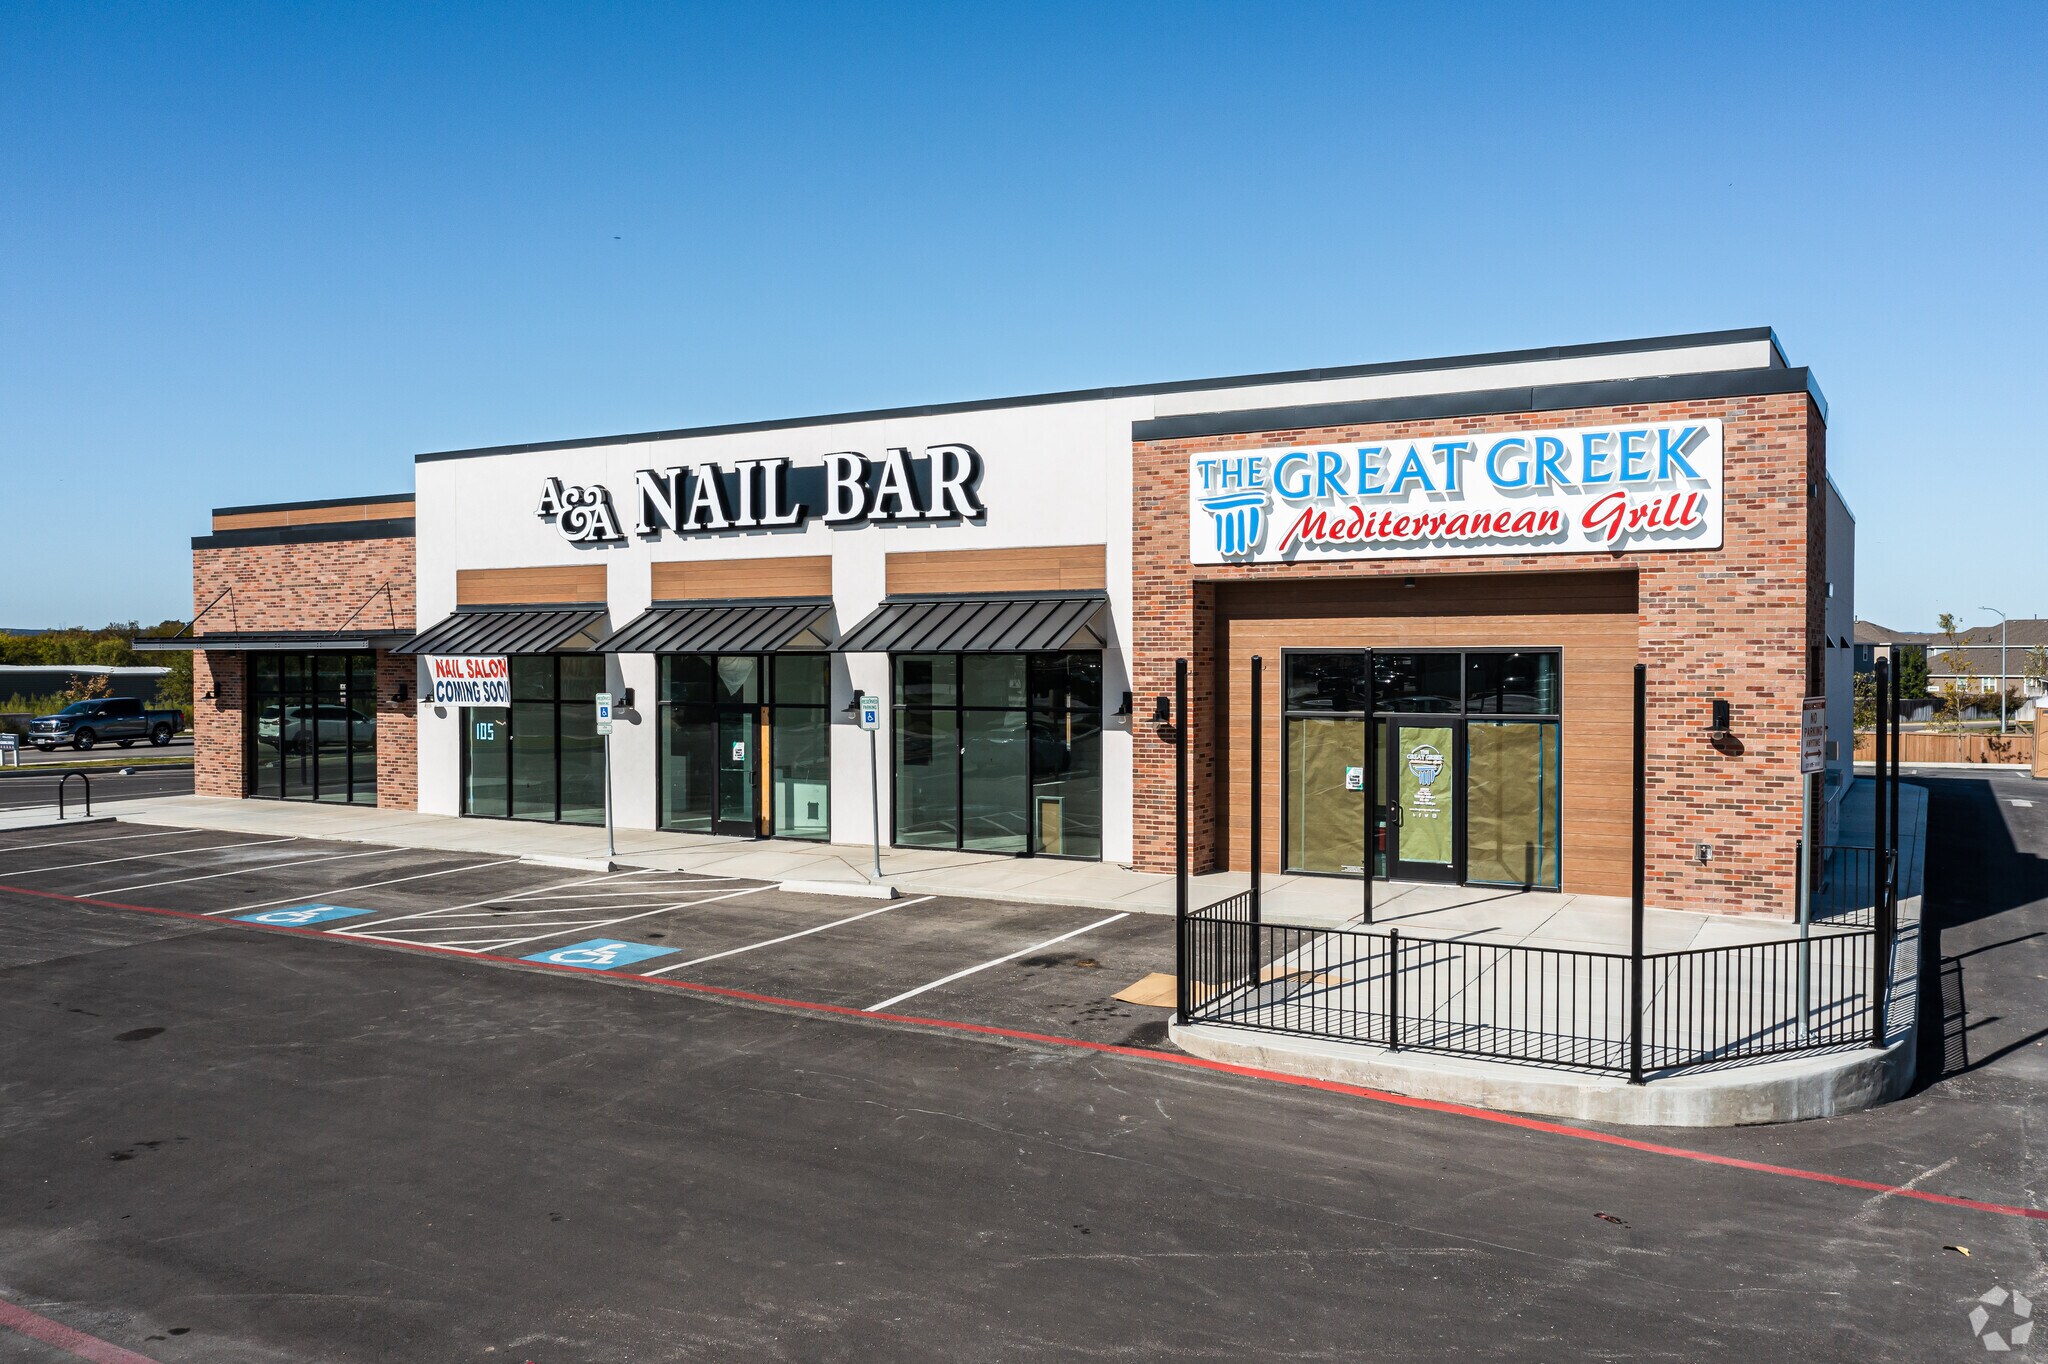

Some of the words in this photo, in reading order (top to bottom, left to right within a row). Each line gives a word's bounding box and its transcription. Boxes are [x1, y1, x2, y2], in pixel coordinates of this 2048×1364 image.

[1196, 456, 1269, 490] THE
[1273, 440, 1471, 500] GREAT
[1485, 426, 1705, 491] GREEK
[534, 477, 624, 543] A&A
[634, 458, 803, 535] NAIL
[822, 444, 982, 523] BAR
[1278, 504, 1563, 551] Mediterranean
[1581, 490, 1700, 541] Grill
[435, 659, 464, 678] NAIL
[466, 658, 508, 679] SALON
[436, 680, 481, 703] COMING
[482, 680, 510, 703] SOON
[1810, 712, 1818, 724] NO
[476, 722, 494, 741] 105
[1804, 725, 1823, 738] PARKING
